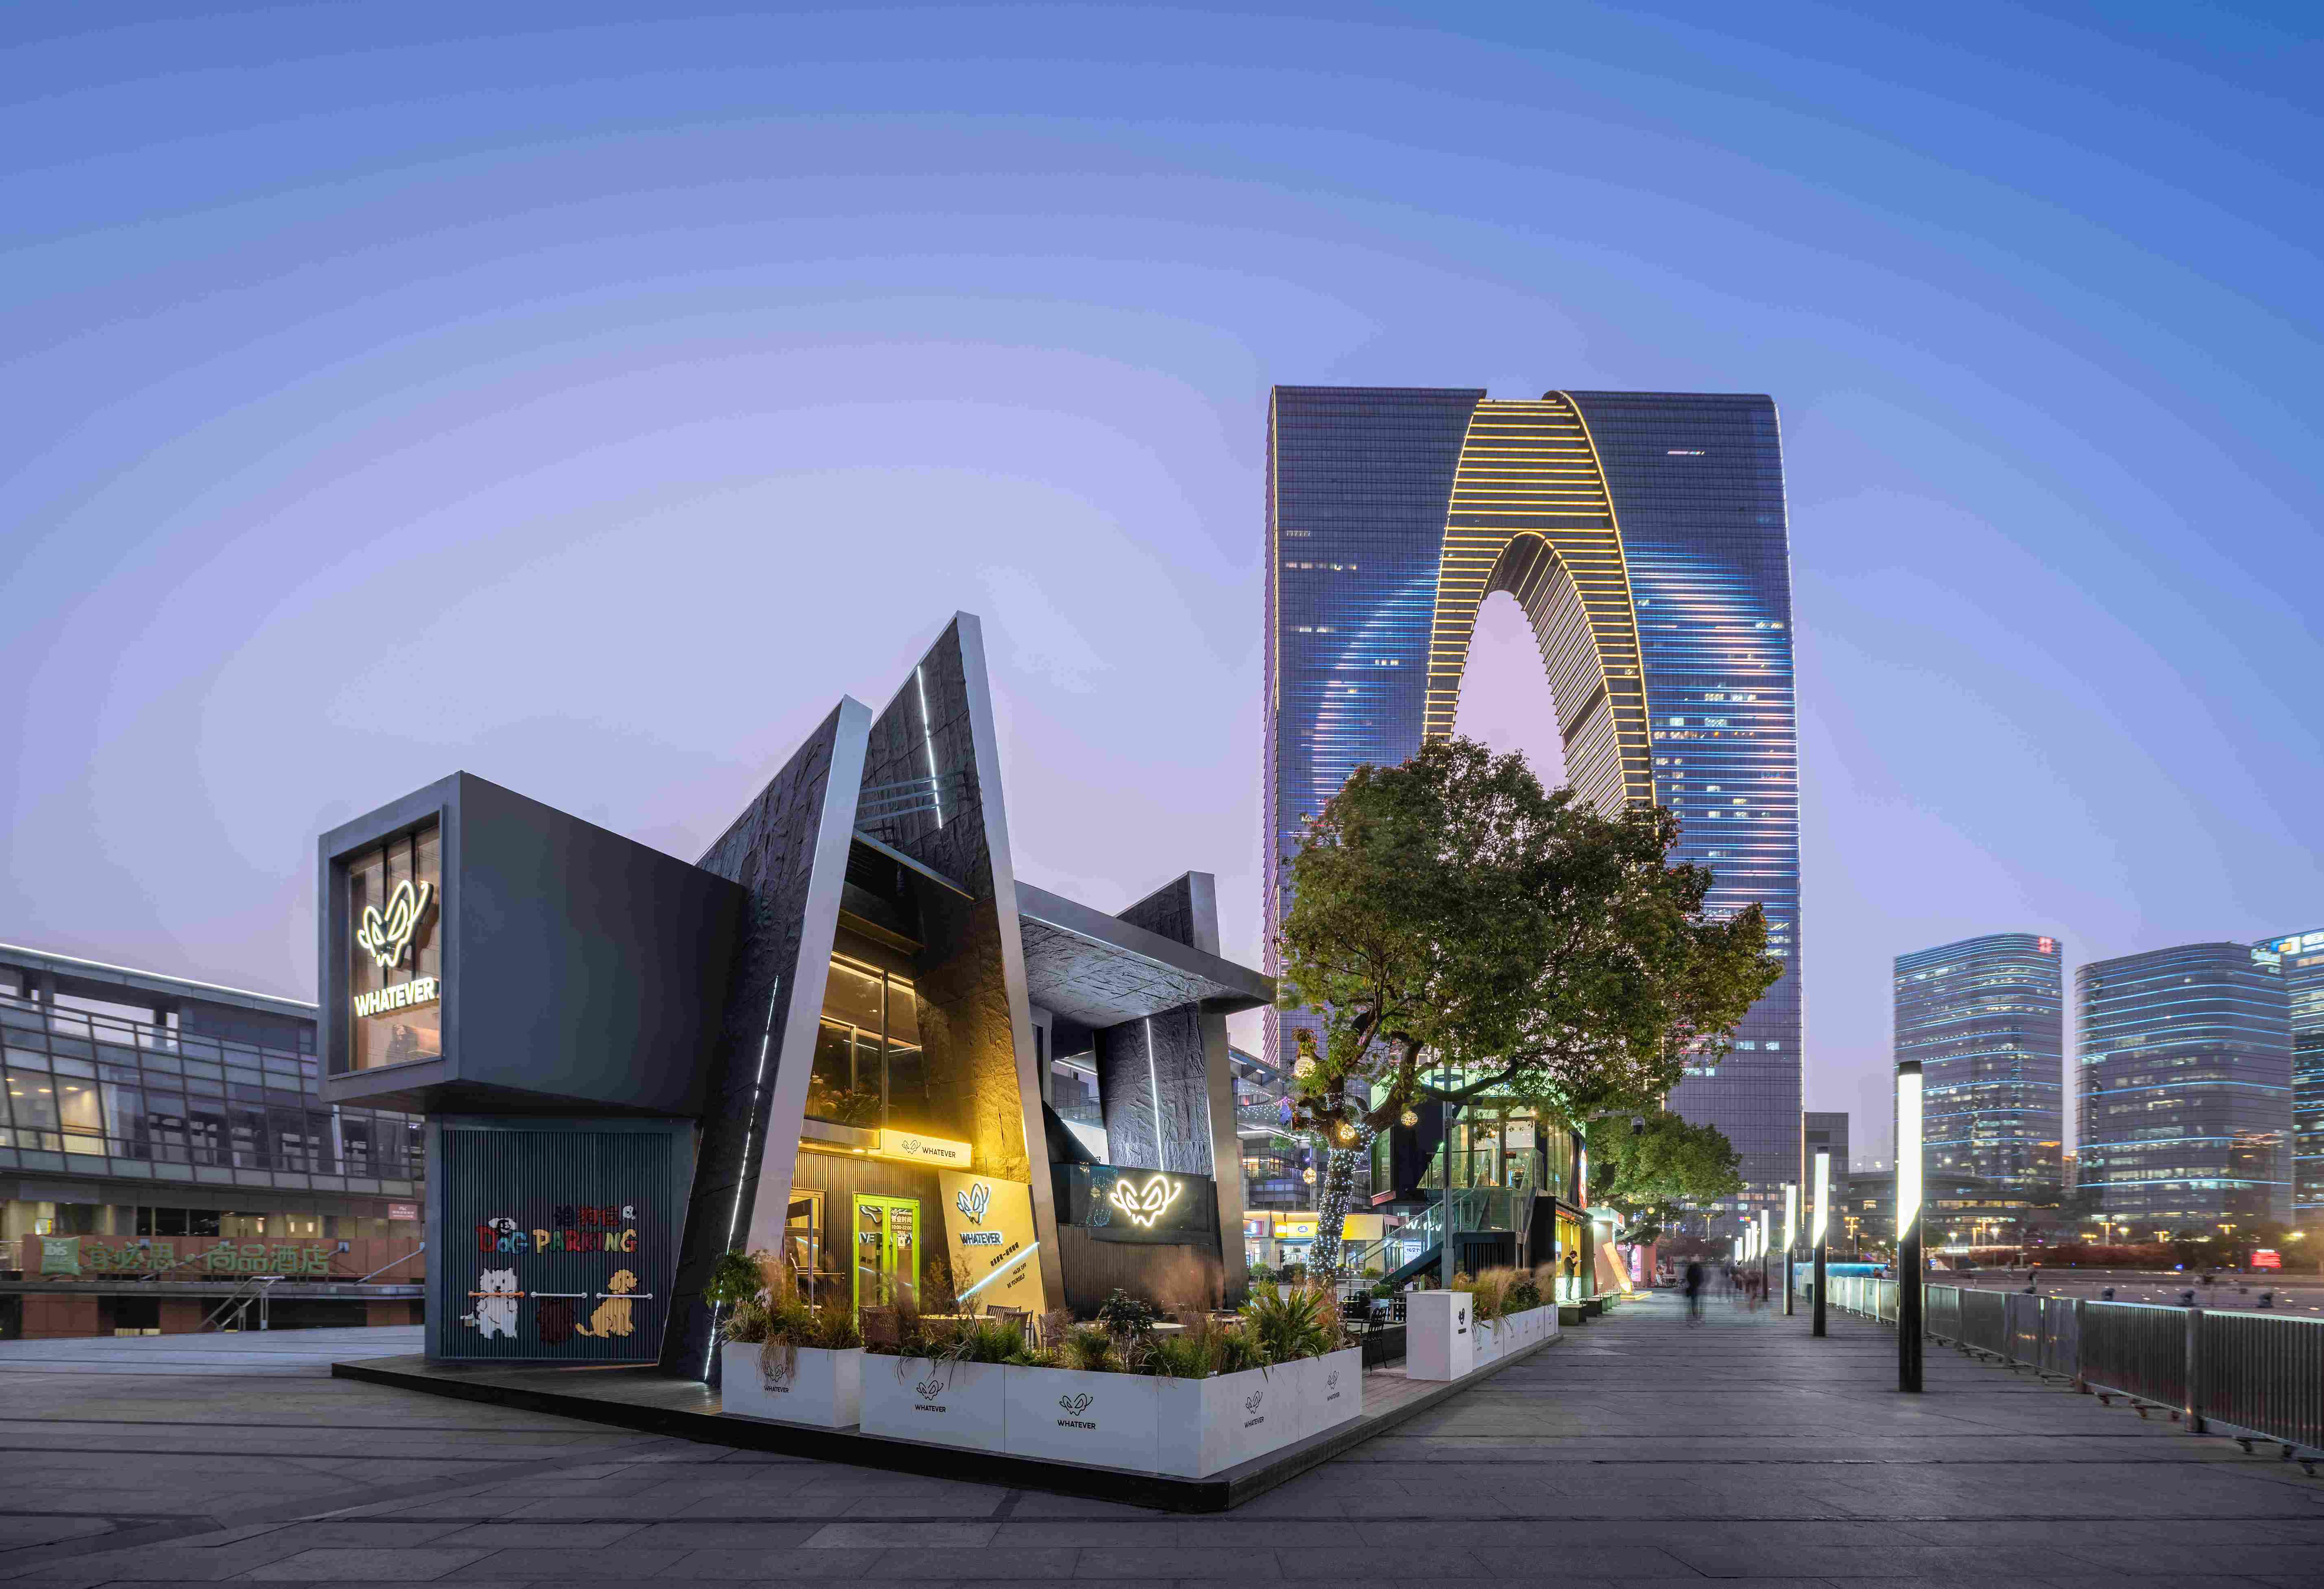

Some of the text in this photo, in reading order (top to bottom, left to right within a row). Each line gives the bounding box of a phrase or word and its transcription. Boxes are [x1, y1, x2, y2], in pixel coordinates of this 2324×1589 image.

[354, 977, 435, 1017] WHATEVER
[922, 1146, 956, 1158] WHATEVER
[532, 1228, 638, 1255] PARKING
[960, 1232, 1002, 1244] WHATEVER
[44, 1242, 68, 1256] ibis
[764, 1385, 789, 1393] WHATEVER
[1327, 1392, 1340, 1402] WHATEVER
[915, 1404, 946, 1413] WHATEVER
[1057, 1419, 1096, 1430] WHATEVER
[1244, 1416, 1264, 1428] WHATEVER
